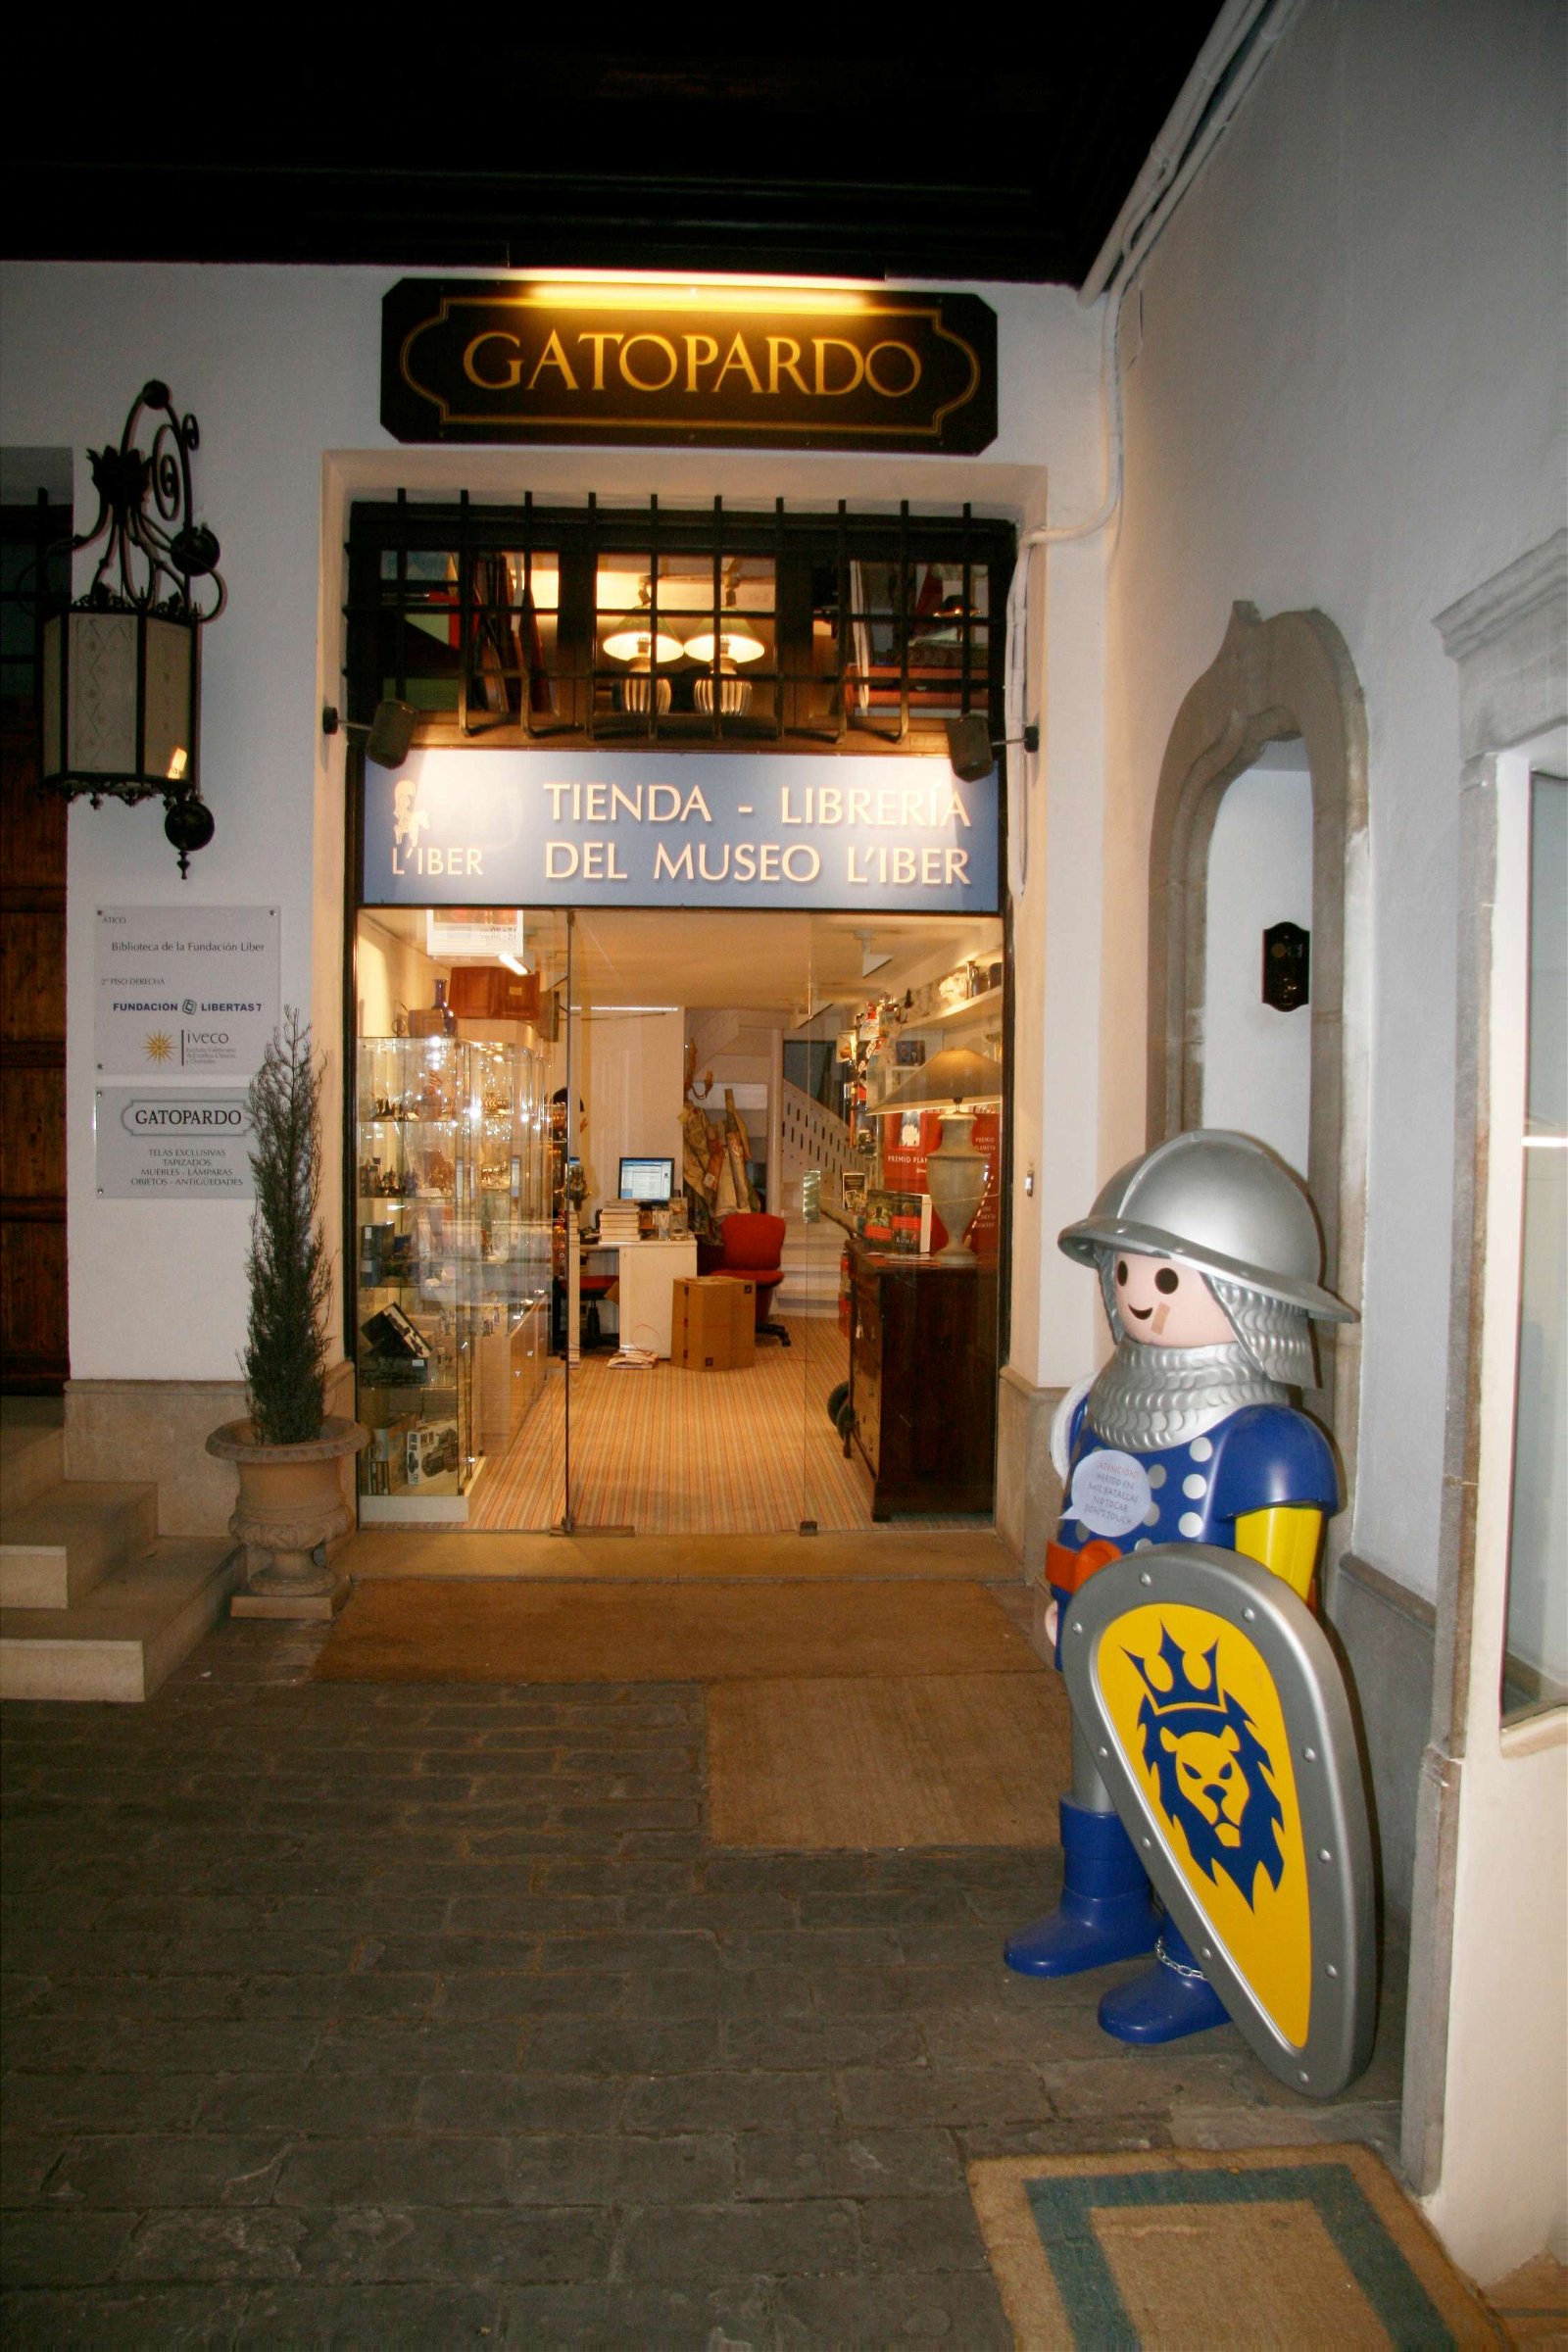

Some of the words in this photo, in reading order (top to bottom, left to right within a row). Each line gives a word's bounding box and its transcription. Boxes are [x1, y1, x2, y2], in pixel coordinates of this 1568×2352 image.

[462, 329, 922, 397] GATOPARDO
[543, 783, 712, 822] TIENDA
[780, 779, 972, 827] LIBRERÍA
[392, 846, 484, 875] L'IBER
[545, 841, 628, 880] DEL
[653, 842, 821, 882] MUSEO
[847, 846, 972, 885] L'IBER
[112, 942, 159, 952] Biblioteca
[162, 942, 173, 952] de
[176, 942, 185, 952] la
[187, 942, 238, 952] Fundación
[240, 942, 266, 952] Liber
[134, 1109, 242, 1126] GATOPARDO
[887, 1155, 911, 1164] PREMIO
